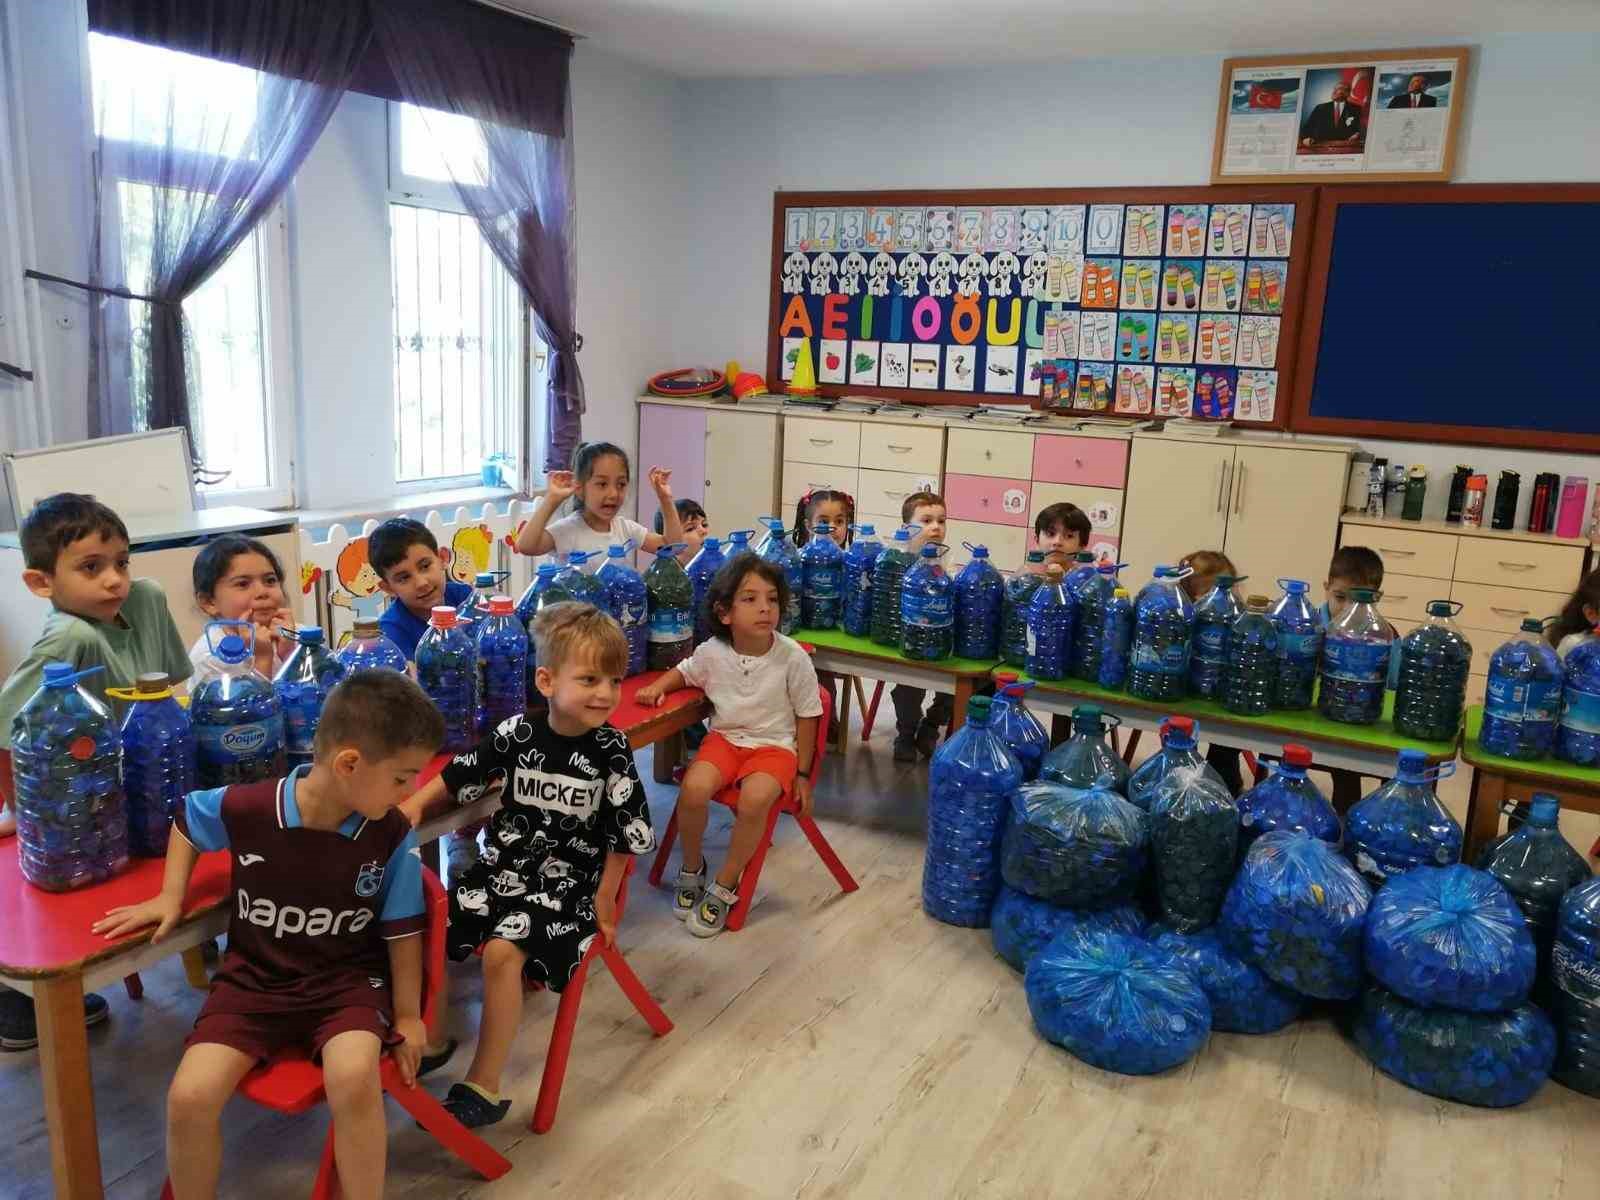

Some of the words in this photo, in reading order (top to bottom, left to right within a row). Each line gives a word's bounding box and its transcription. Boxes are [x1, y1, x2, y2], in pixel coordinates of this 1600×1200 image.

[793, 218, 800, 240] 1
[818, 216, 831, 240] 2
[846, 215, 859, 240] 3
[875, 215, 887, 239] 4
[902, 216, 915, 240] 5
[931, 219, 945, 240] 6
[994, 215, 1008, 240] 8
[1058, 219, 1079, 240] 10
[789, 276, 796, 287] 1
[816, 277, 823, 288] 2
[844, 276, 852, 287] 3
[872, 276, 881, 288] 4
[902, 279, 910, 290] 5
[934, 278, 942, 290] 6
[964, 279, 971, 290] 7
[995, 278, 1002, 289] 8
[1028, 278, 1036, 289] 9
[780, 295, 813, 337] A
[822, 292, 850, 340] E
[861, 293, 873, 340] I
[911, 295, 942, 341] O
[950, 291, 982, 345] Ö
[986, 297, 1022, 346] U
[517, 776, 600, 807] MICKEY
